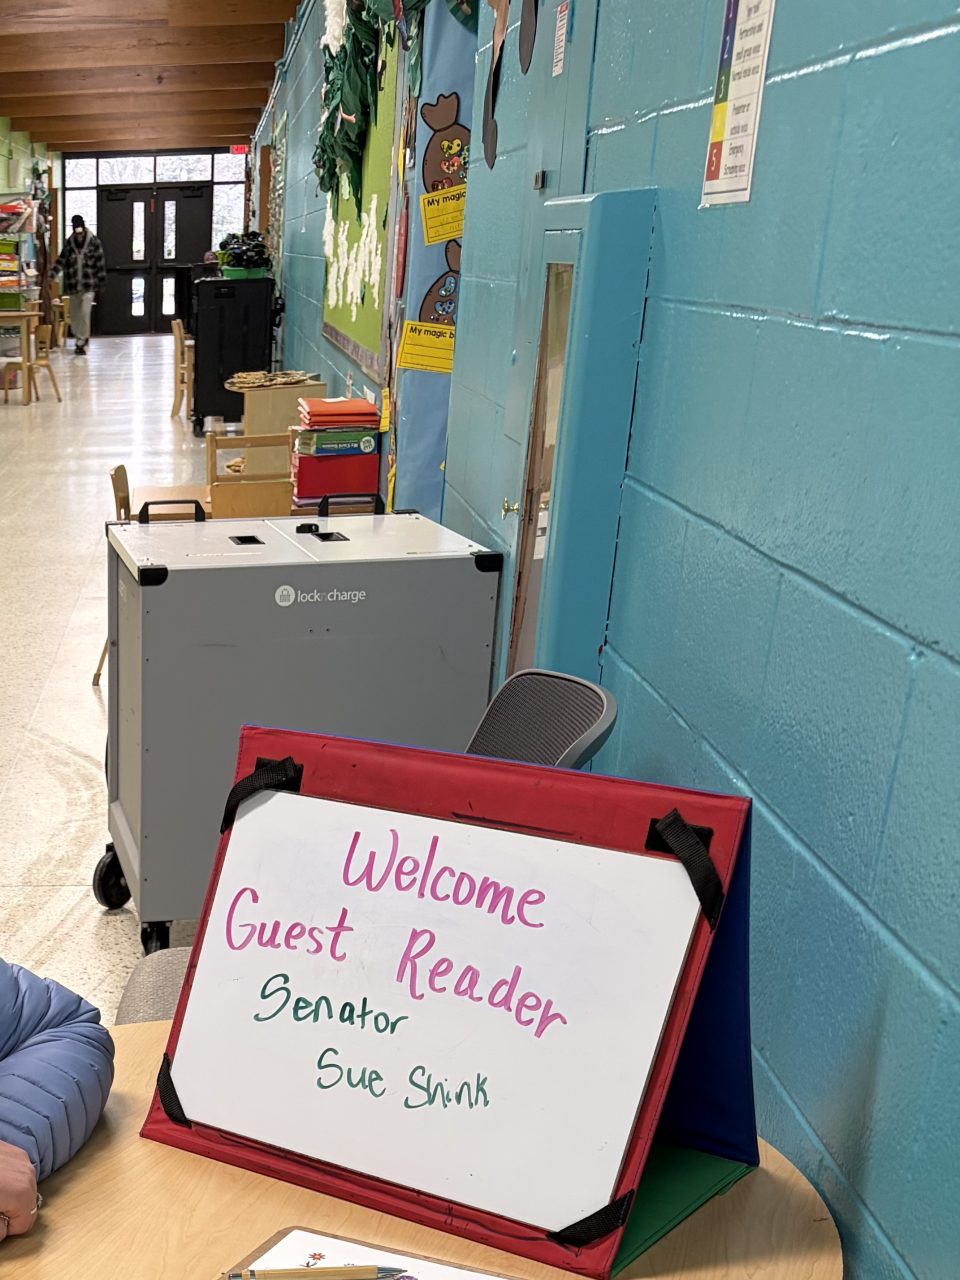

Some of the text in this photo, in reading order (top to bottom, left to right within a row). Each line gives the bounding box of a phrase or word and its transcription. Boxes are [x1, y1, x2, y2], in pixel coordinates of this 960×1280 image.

[427, 191, 467, 207] My magic
[410, 326, 422, 336] My
[424, 329, 447, 339] magic
[342, 829, 545, 928] Welcome
[226, 887, 567, 1038] Guest Reader
[253, 973, 409, 1034] Senator
[316, 1047, 489, 1109] Sue Shink
